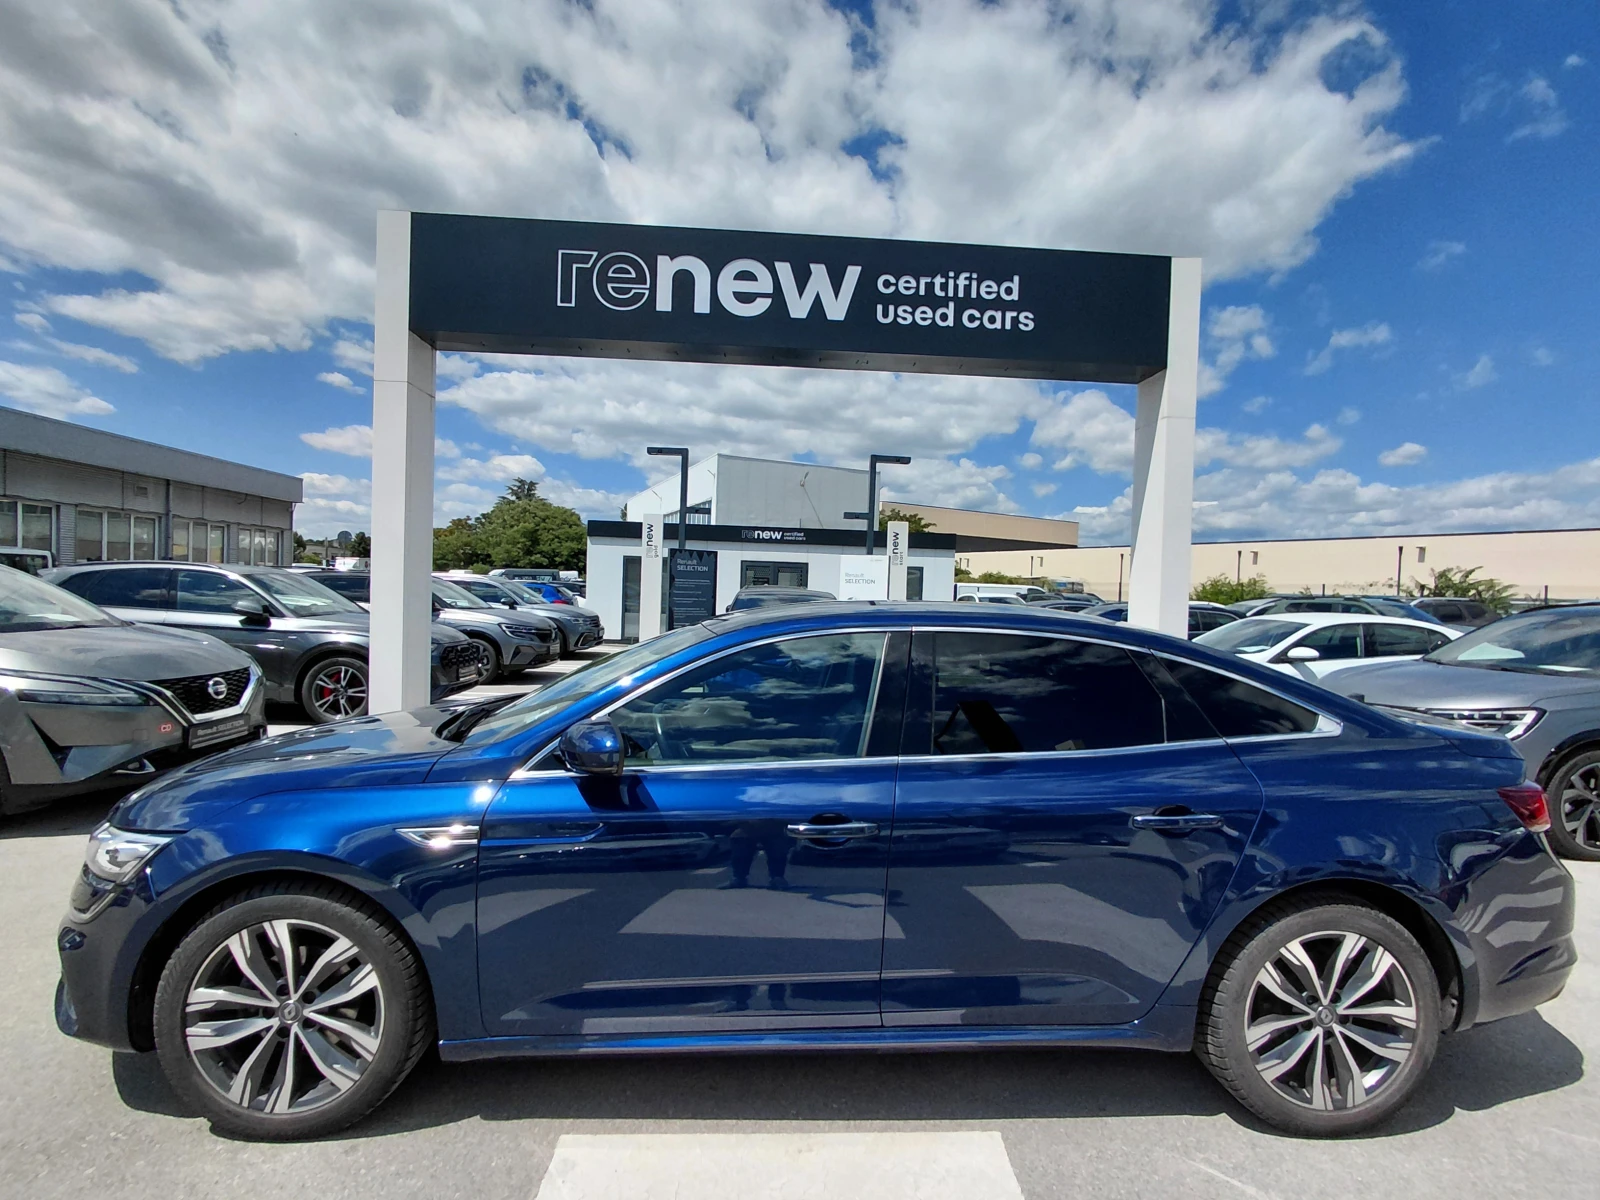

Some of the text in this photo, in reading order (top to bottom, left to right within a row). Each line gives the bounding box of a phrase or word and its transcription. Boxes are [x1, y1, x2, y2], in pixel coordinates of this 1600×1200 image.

[556, 249, 862, 321] renew
[876, 271, 1020, 302] certified
[876, 302, 1035, 332] used cars
[646, 523, 654, 559] renew
[741, 529, 783, 540] renew
[891, 531, 900, 566] renew
[217, 719, 245, 731] SELECTION
